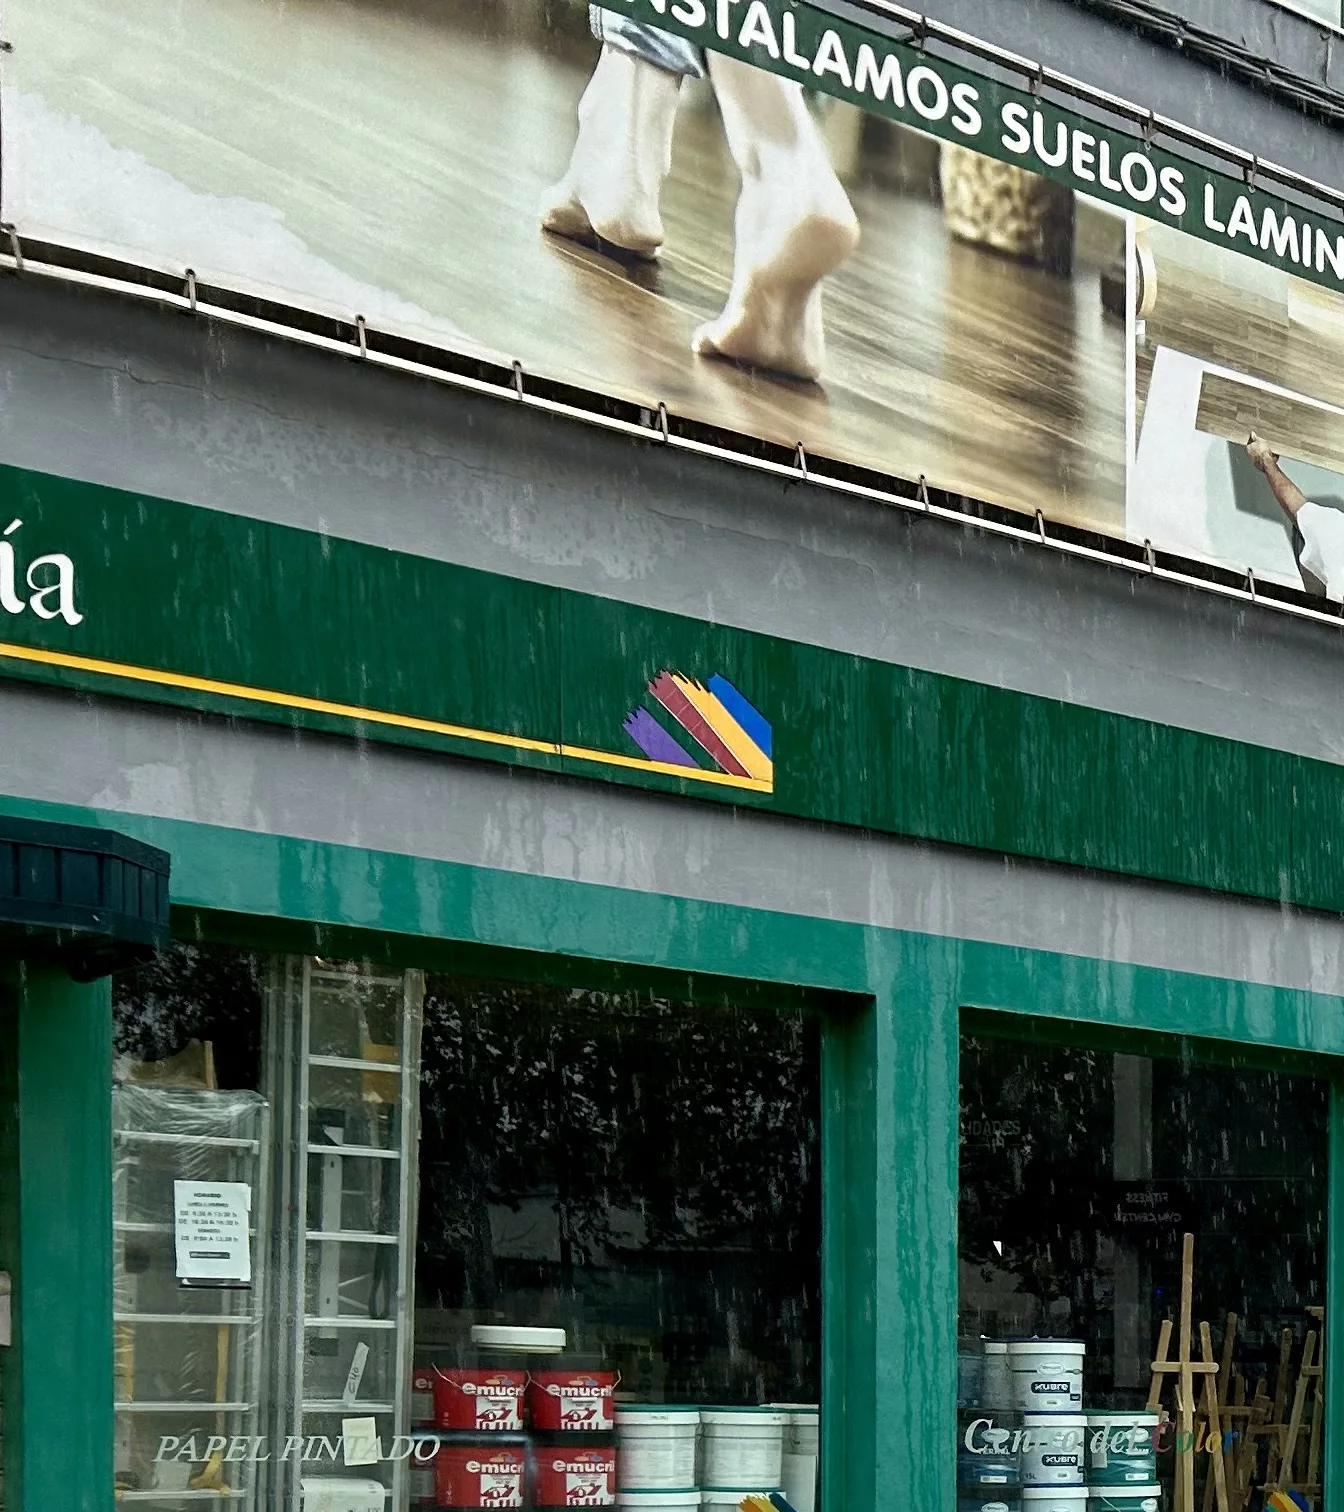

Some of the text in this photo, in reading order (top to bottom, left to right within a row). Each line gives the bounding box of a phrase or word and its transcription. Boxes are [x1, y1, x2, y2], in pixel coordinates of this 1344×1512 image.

[1001, 102, 1187, 216] SUELOS
[152, 1435, 441, 1462] PAPEL PINTADO
[1090, 1421, 1141, 1453] del
[1152, 1421, 1240, 1454] Color
